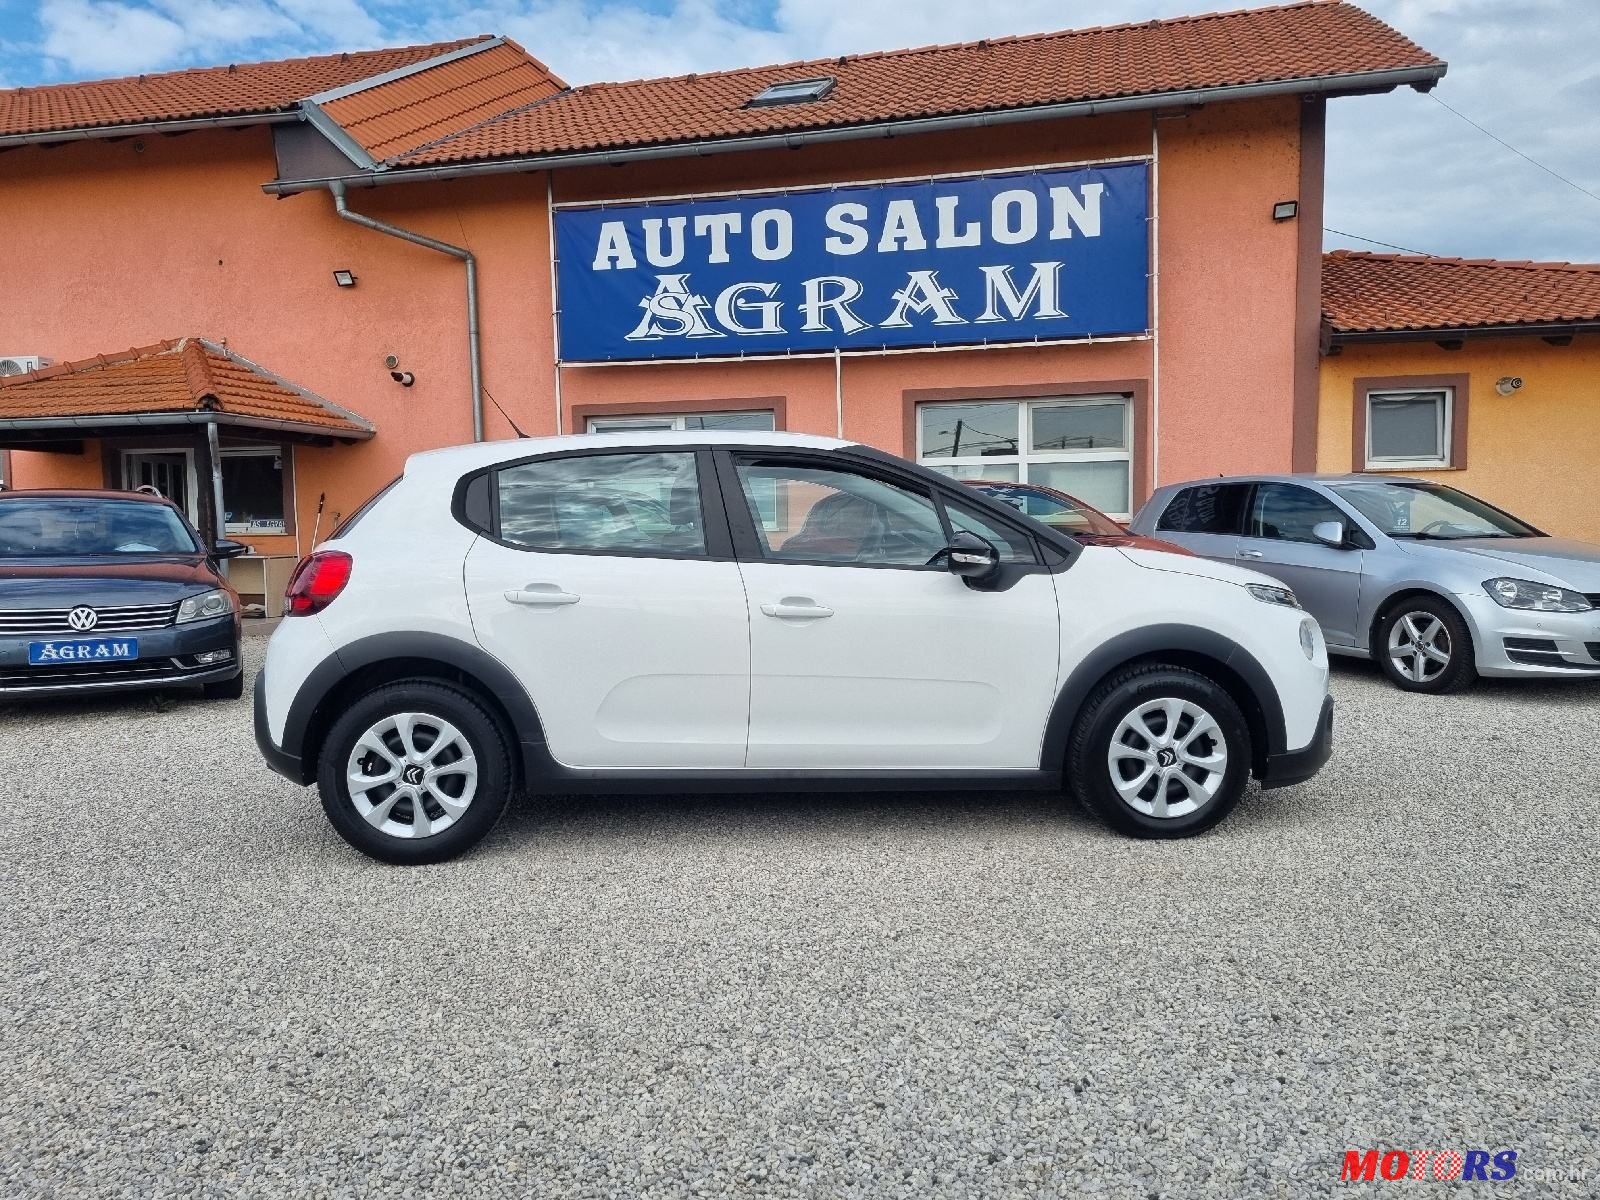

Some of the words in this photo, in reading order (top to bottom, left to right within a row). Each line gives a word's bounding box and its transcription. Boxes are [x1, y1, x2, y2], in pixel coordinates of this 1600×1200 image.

[592, 208, 793, 271] AUTO
[825, 183, 1104, 255] SALON
[68, 607, 98, 631] VW
